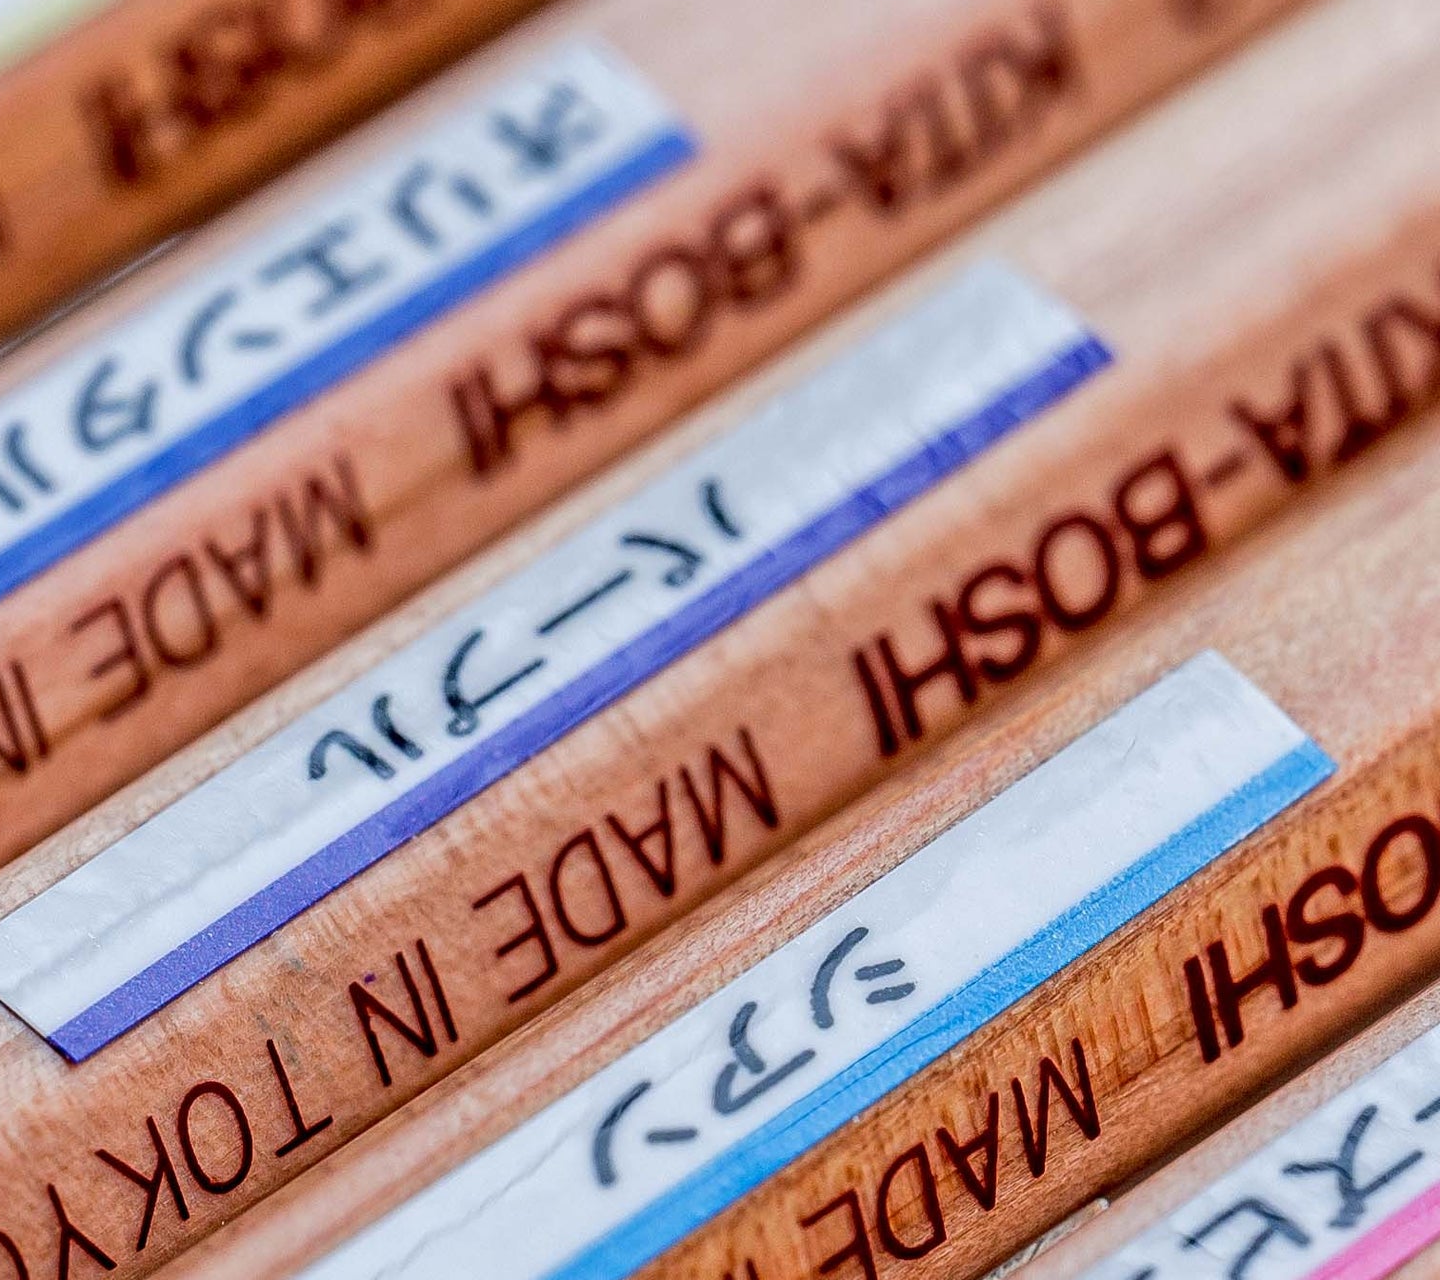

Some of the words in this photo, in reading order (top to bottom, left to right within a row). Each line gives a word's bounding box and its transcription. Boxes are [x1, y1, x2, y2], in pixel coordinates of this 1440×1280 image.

[449, 18, 1078, 485] KITA-BOSHI
[70, 462, 374, 726] MADE
[307, 478, 739, 781] パープル
[471, 727, 781, 1008] MADE
[348, 939, 457, 1089] IN
[590, 926, 915, 1189] シアン
